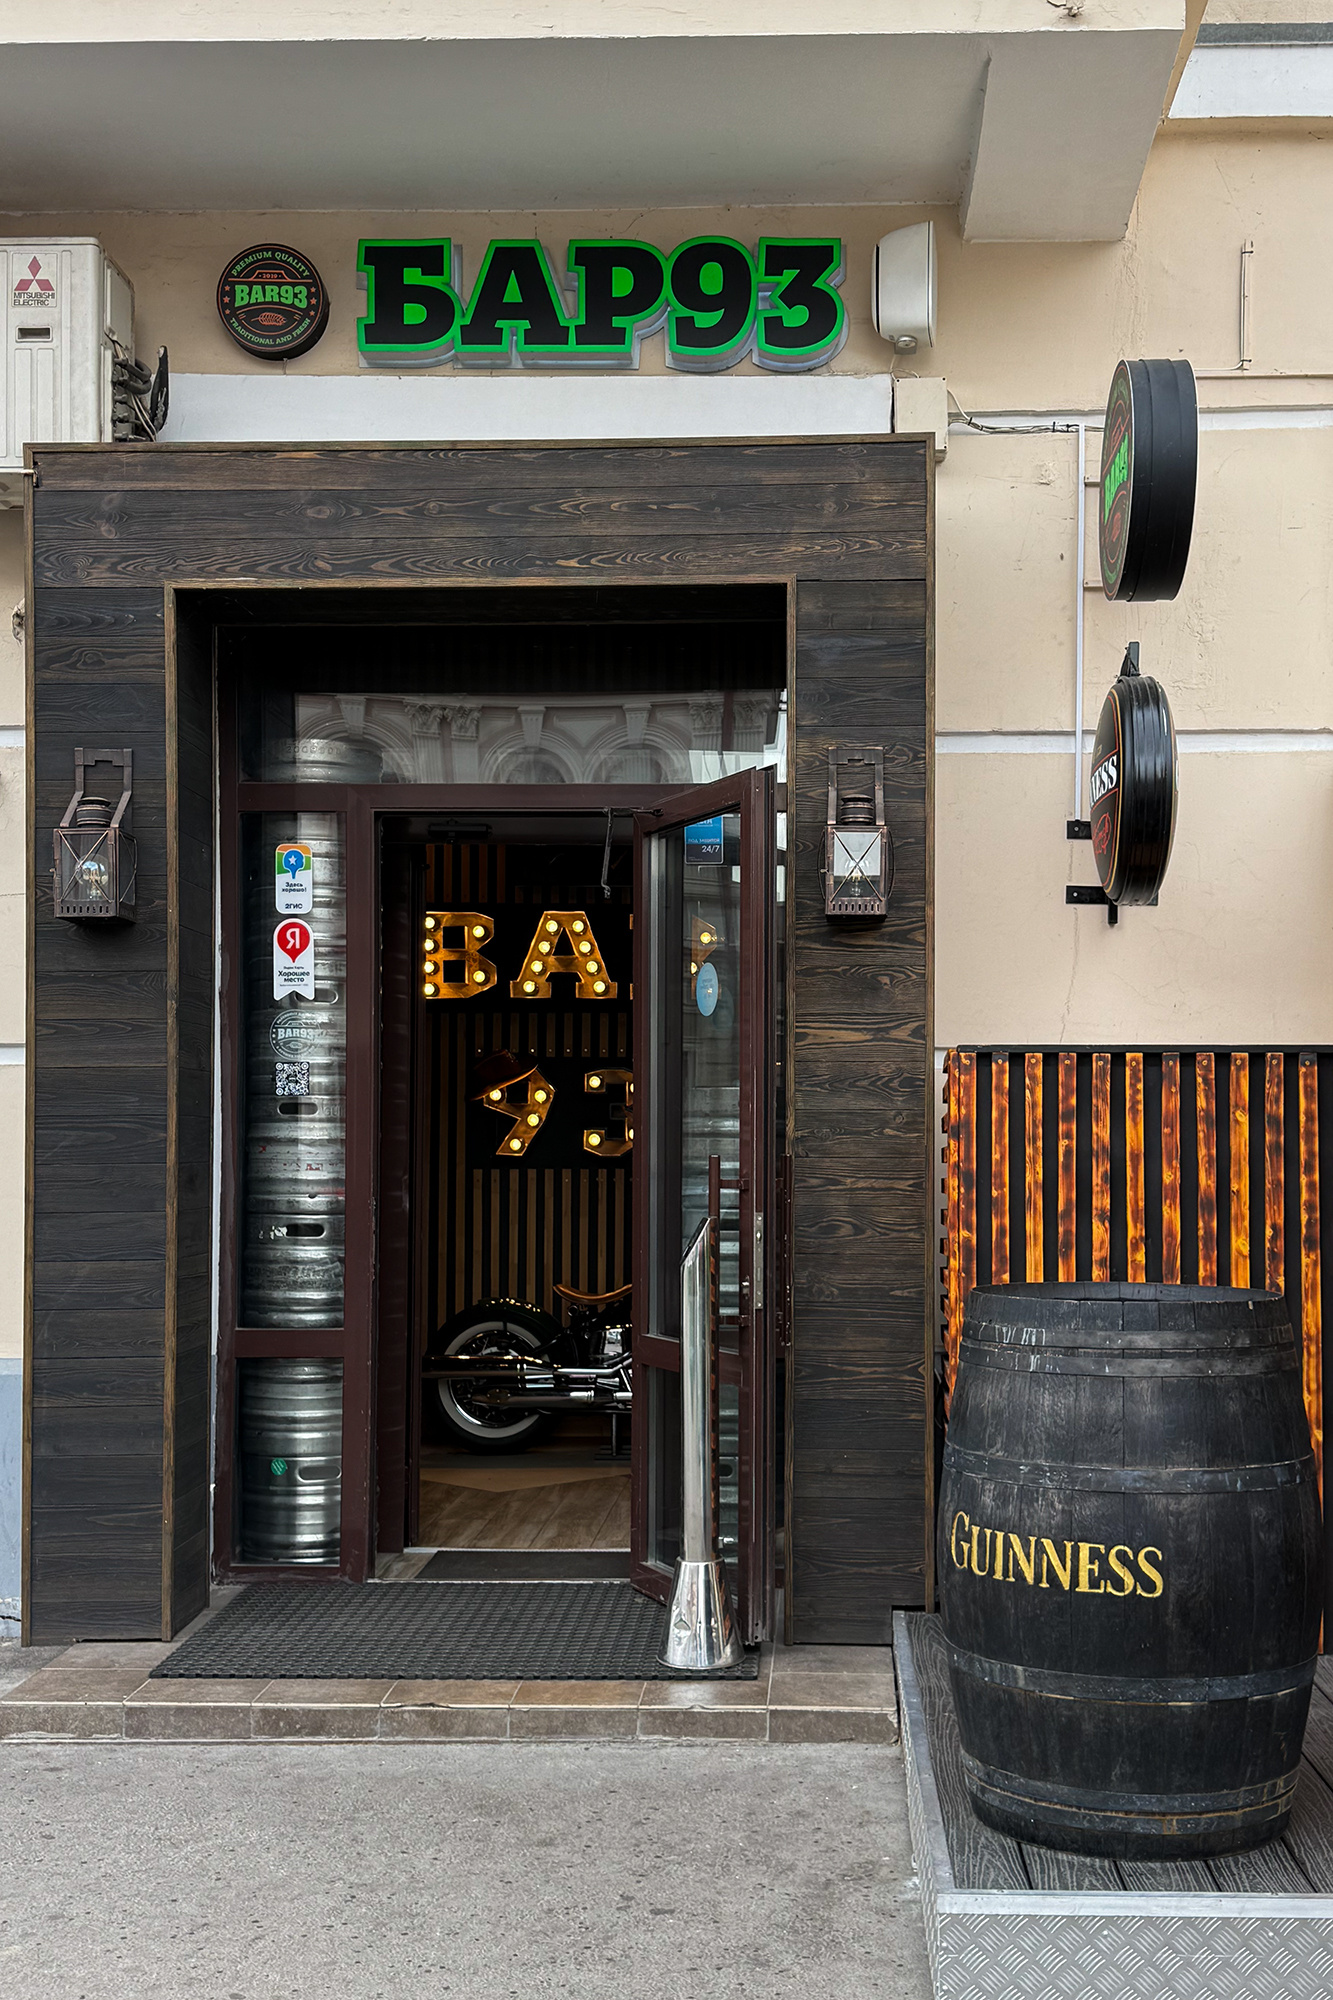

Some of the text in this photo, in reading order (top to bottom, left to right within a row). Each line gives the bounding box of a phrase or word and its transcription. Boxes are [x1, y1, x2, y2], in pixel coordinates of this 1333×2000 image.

[231, 251, 310, 277] PREMIUM QUALITY
[234, 284, 308, 309] BAR93
[357, 236, 845, 355] БАР93
[230, 317, 312, 345] TRADITIONAL AND FRESH
[701, 845, 720, 854] 24/7
[286, 927, 300, 950] Я
[425, 911, 634, 998] BA
[278, 970, 310, 978] Хорошее
[277, 1028, 314, 1040] BAR93
[951, 1511, 1164, 1598] GUINNESS
